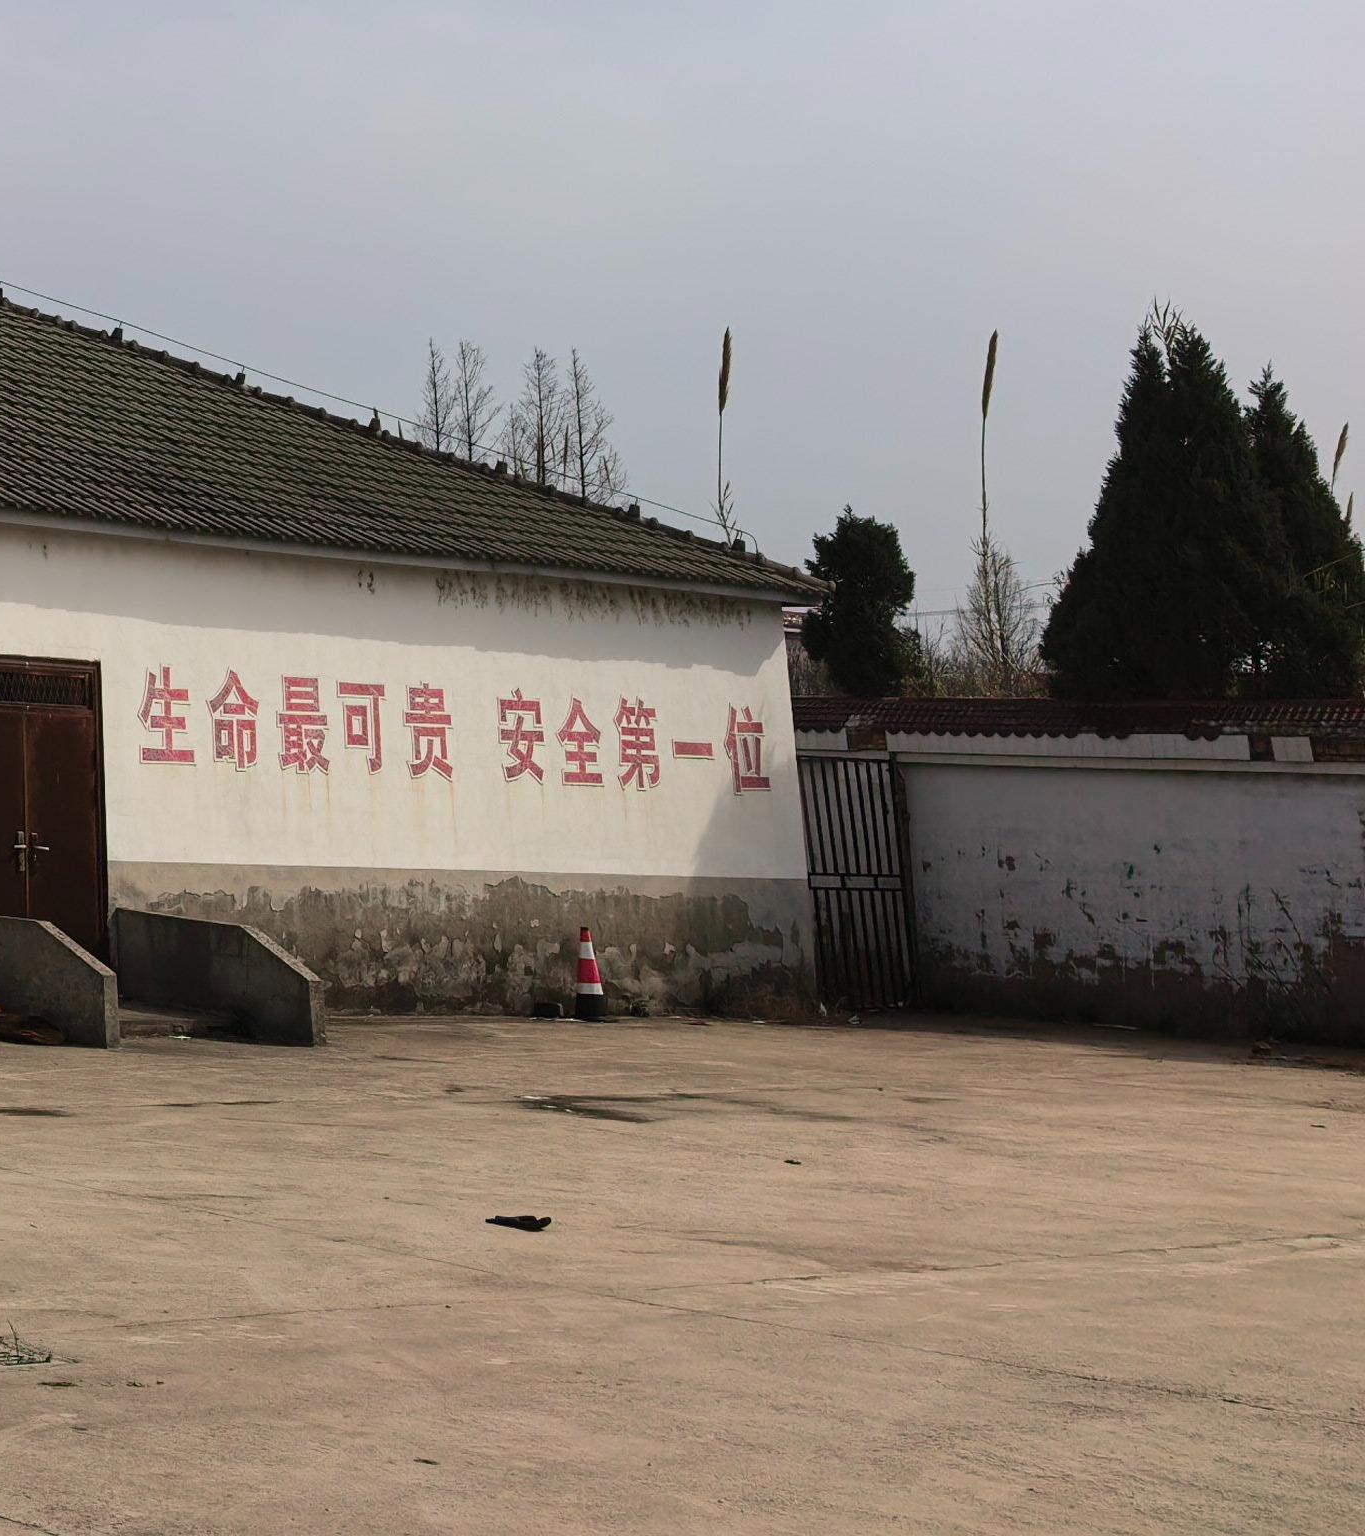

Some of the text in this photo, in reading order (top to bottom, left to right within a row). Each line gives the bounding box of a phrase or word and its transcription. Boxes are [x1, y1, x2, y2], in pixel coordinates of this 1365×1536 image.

[136, 662, 772, 797] 生命最可贵 安全第一位
